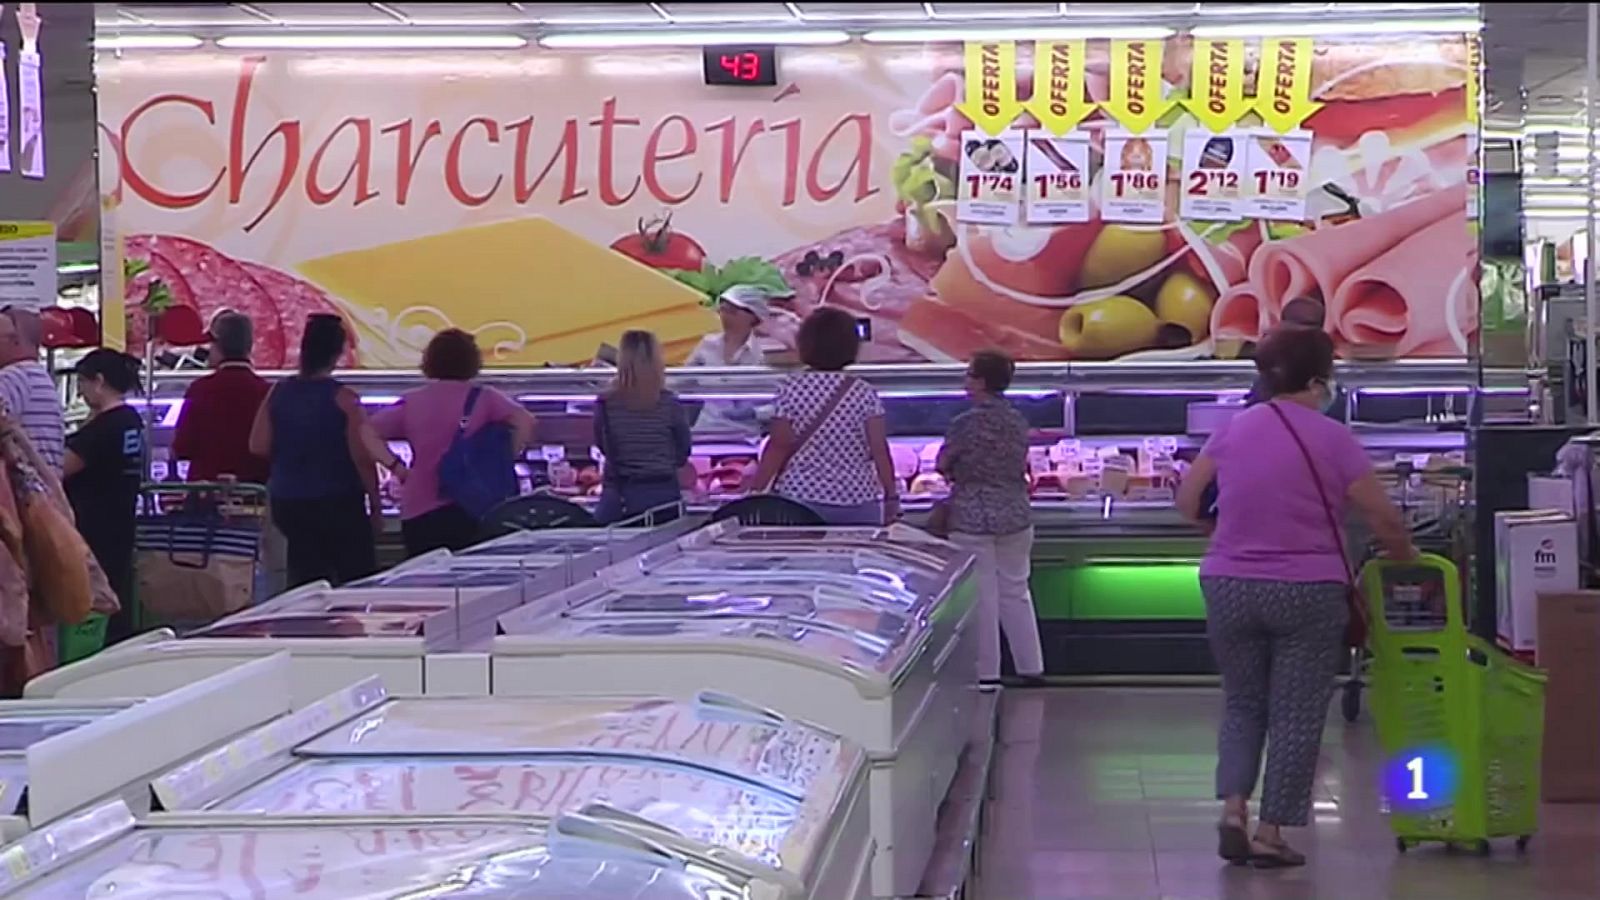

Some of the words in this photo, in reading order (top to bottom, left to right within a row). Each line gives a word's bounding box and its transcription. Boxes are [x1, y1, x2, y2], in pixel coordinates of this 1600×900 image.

[720, 52, 760, 80] 43
[982, 44, 1000, 116] OFERTA
[1050, 44, 1070, 116] OFERTA
[1127, 43, 1146, 115] OFERTA
[1208, 42, 1228, 113] OFERTA
[1274, 41, 1296, 113] OFERTA
[121, 56, 880, 232] Charcutería
[1534, 549, 1557, 563] fm
